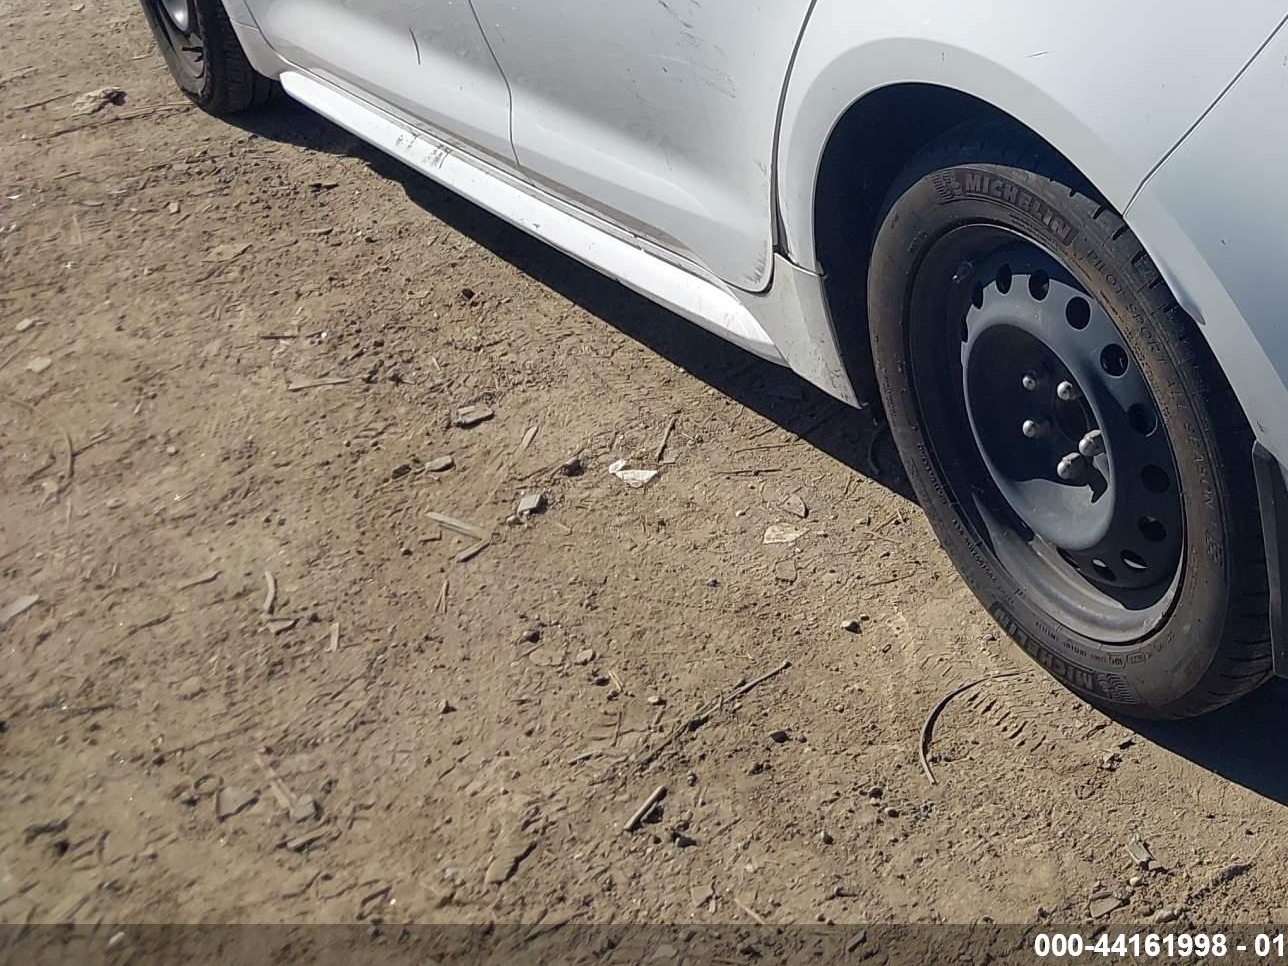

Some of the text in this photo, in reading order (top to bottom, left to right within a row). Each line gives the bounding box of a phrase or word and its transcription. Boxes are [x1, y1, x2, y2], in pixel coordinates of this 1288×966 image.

[965, 174, 1072, 240] MICHELIN
[1086, 248, 1126, 295] PILOT
[1125, 302, 1166, 363] SPORT
